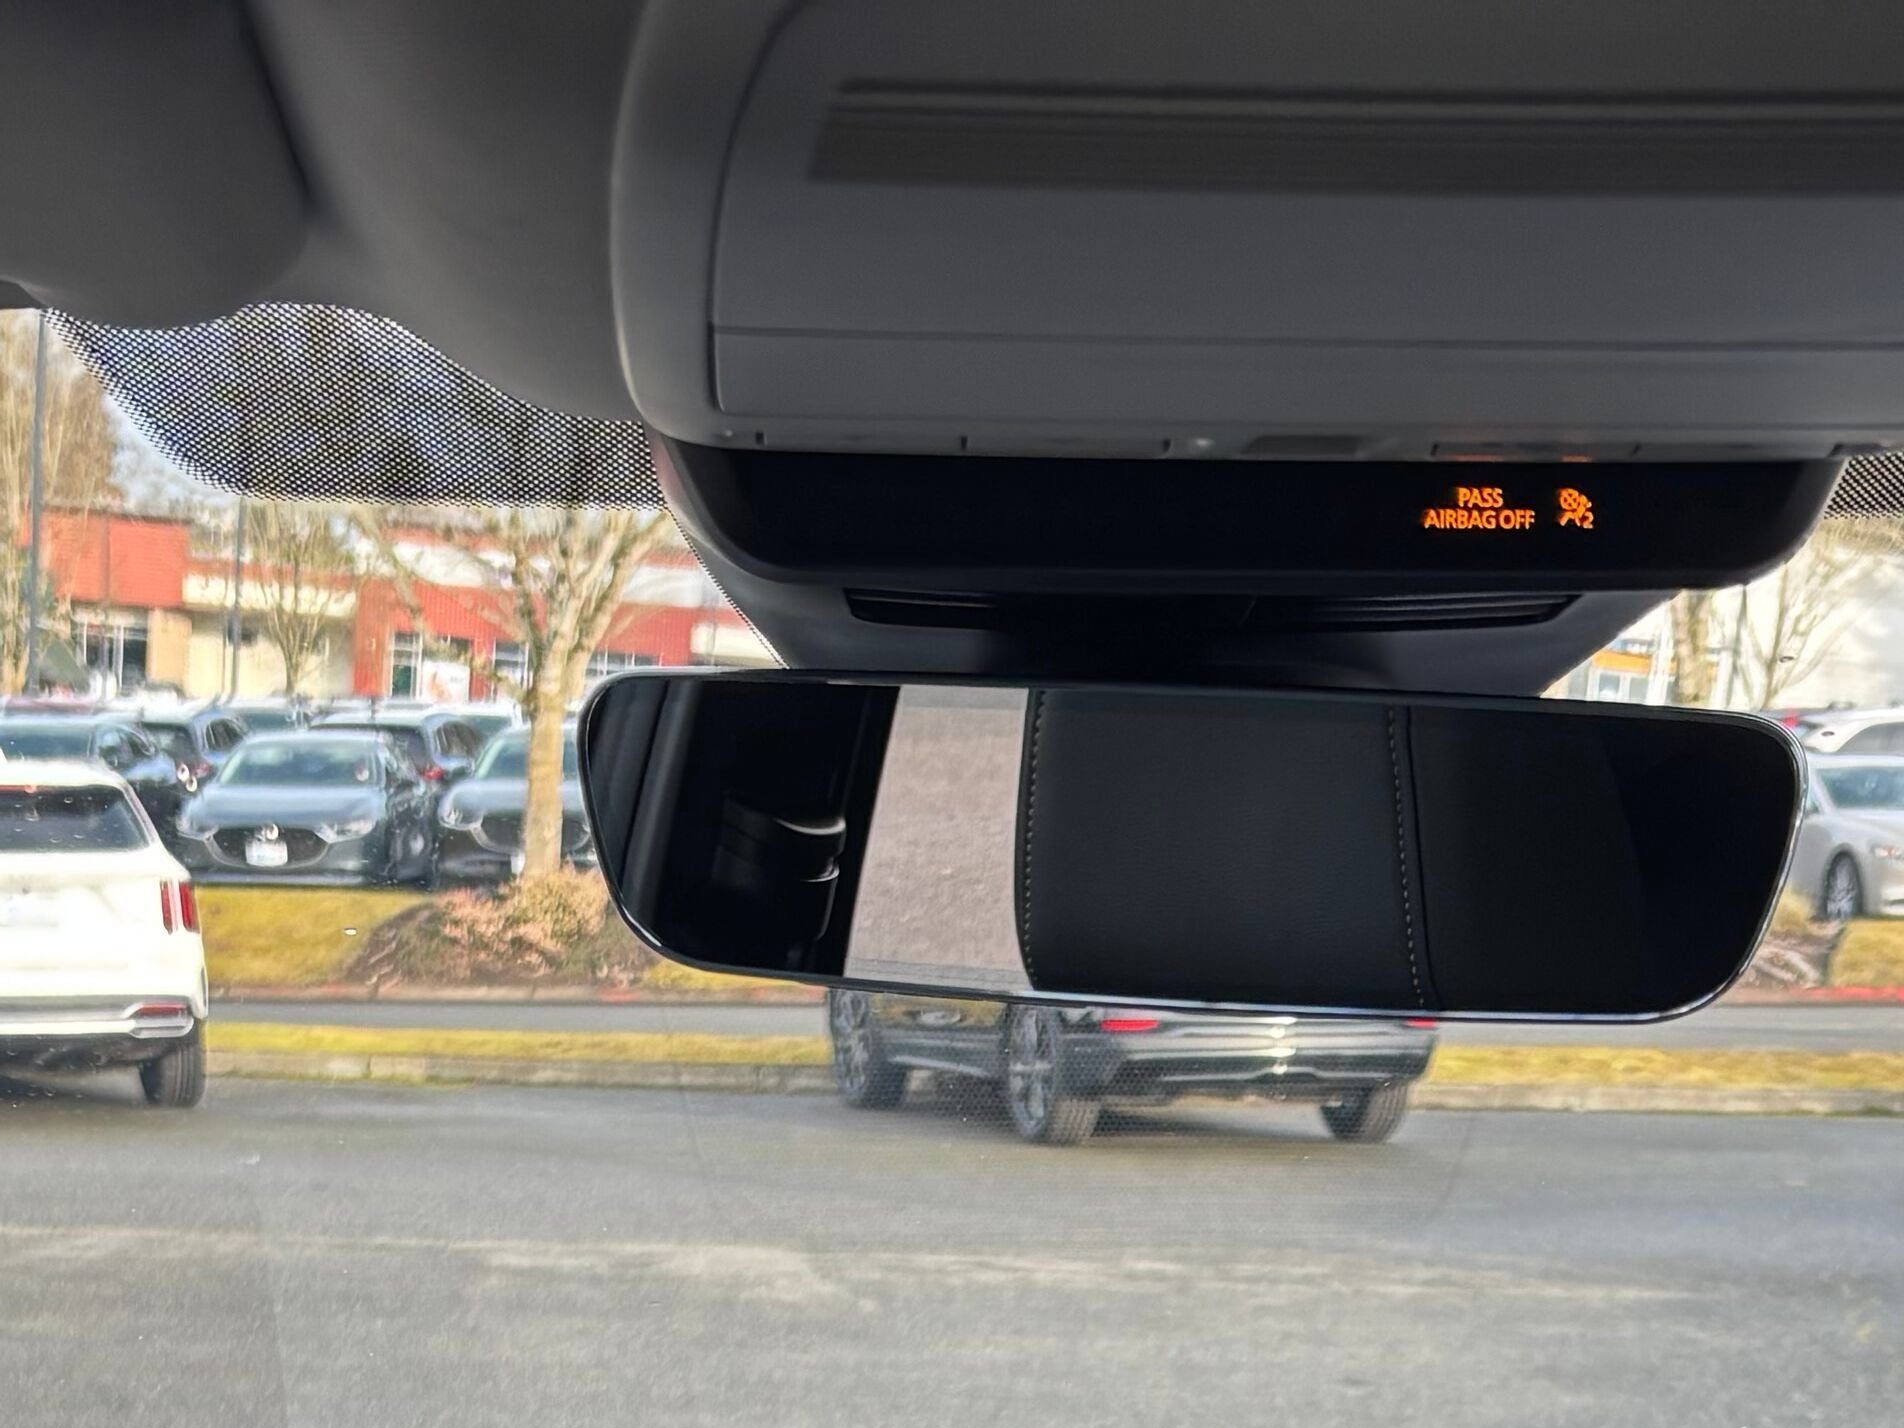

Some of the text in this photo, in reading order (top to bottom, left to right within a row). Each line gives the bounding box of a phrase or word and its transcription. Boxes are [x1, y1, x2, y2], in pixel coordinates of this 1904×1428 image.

[1457, 487, 1503, 508] PASS
[1424, 509, 1536, 530] AIRBAG OFF
